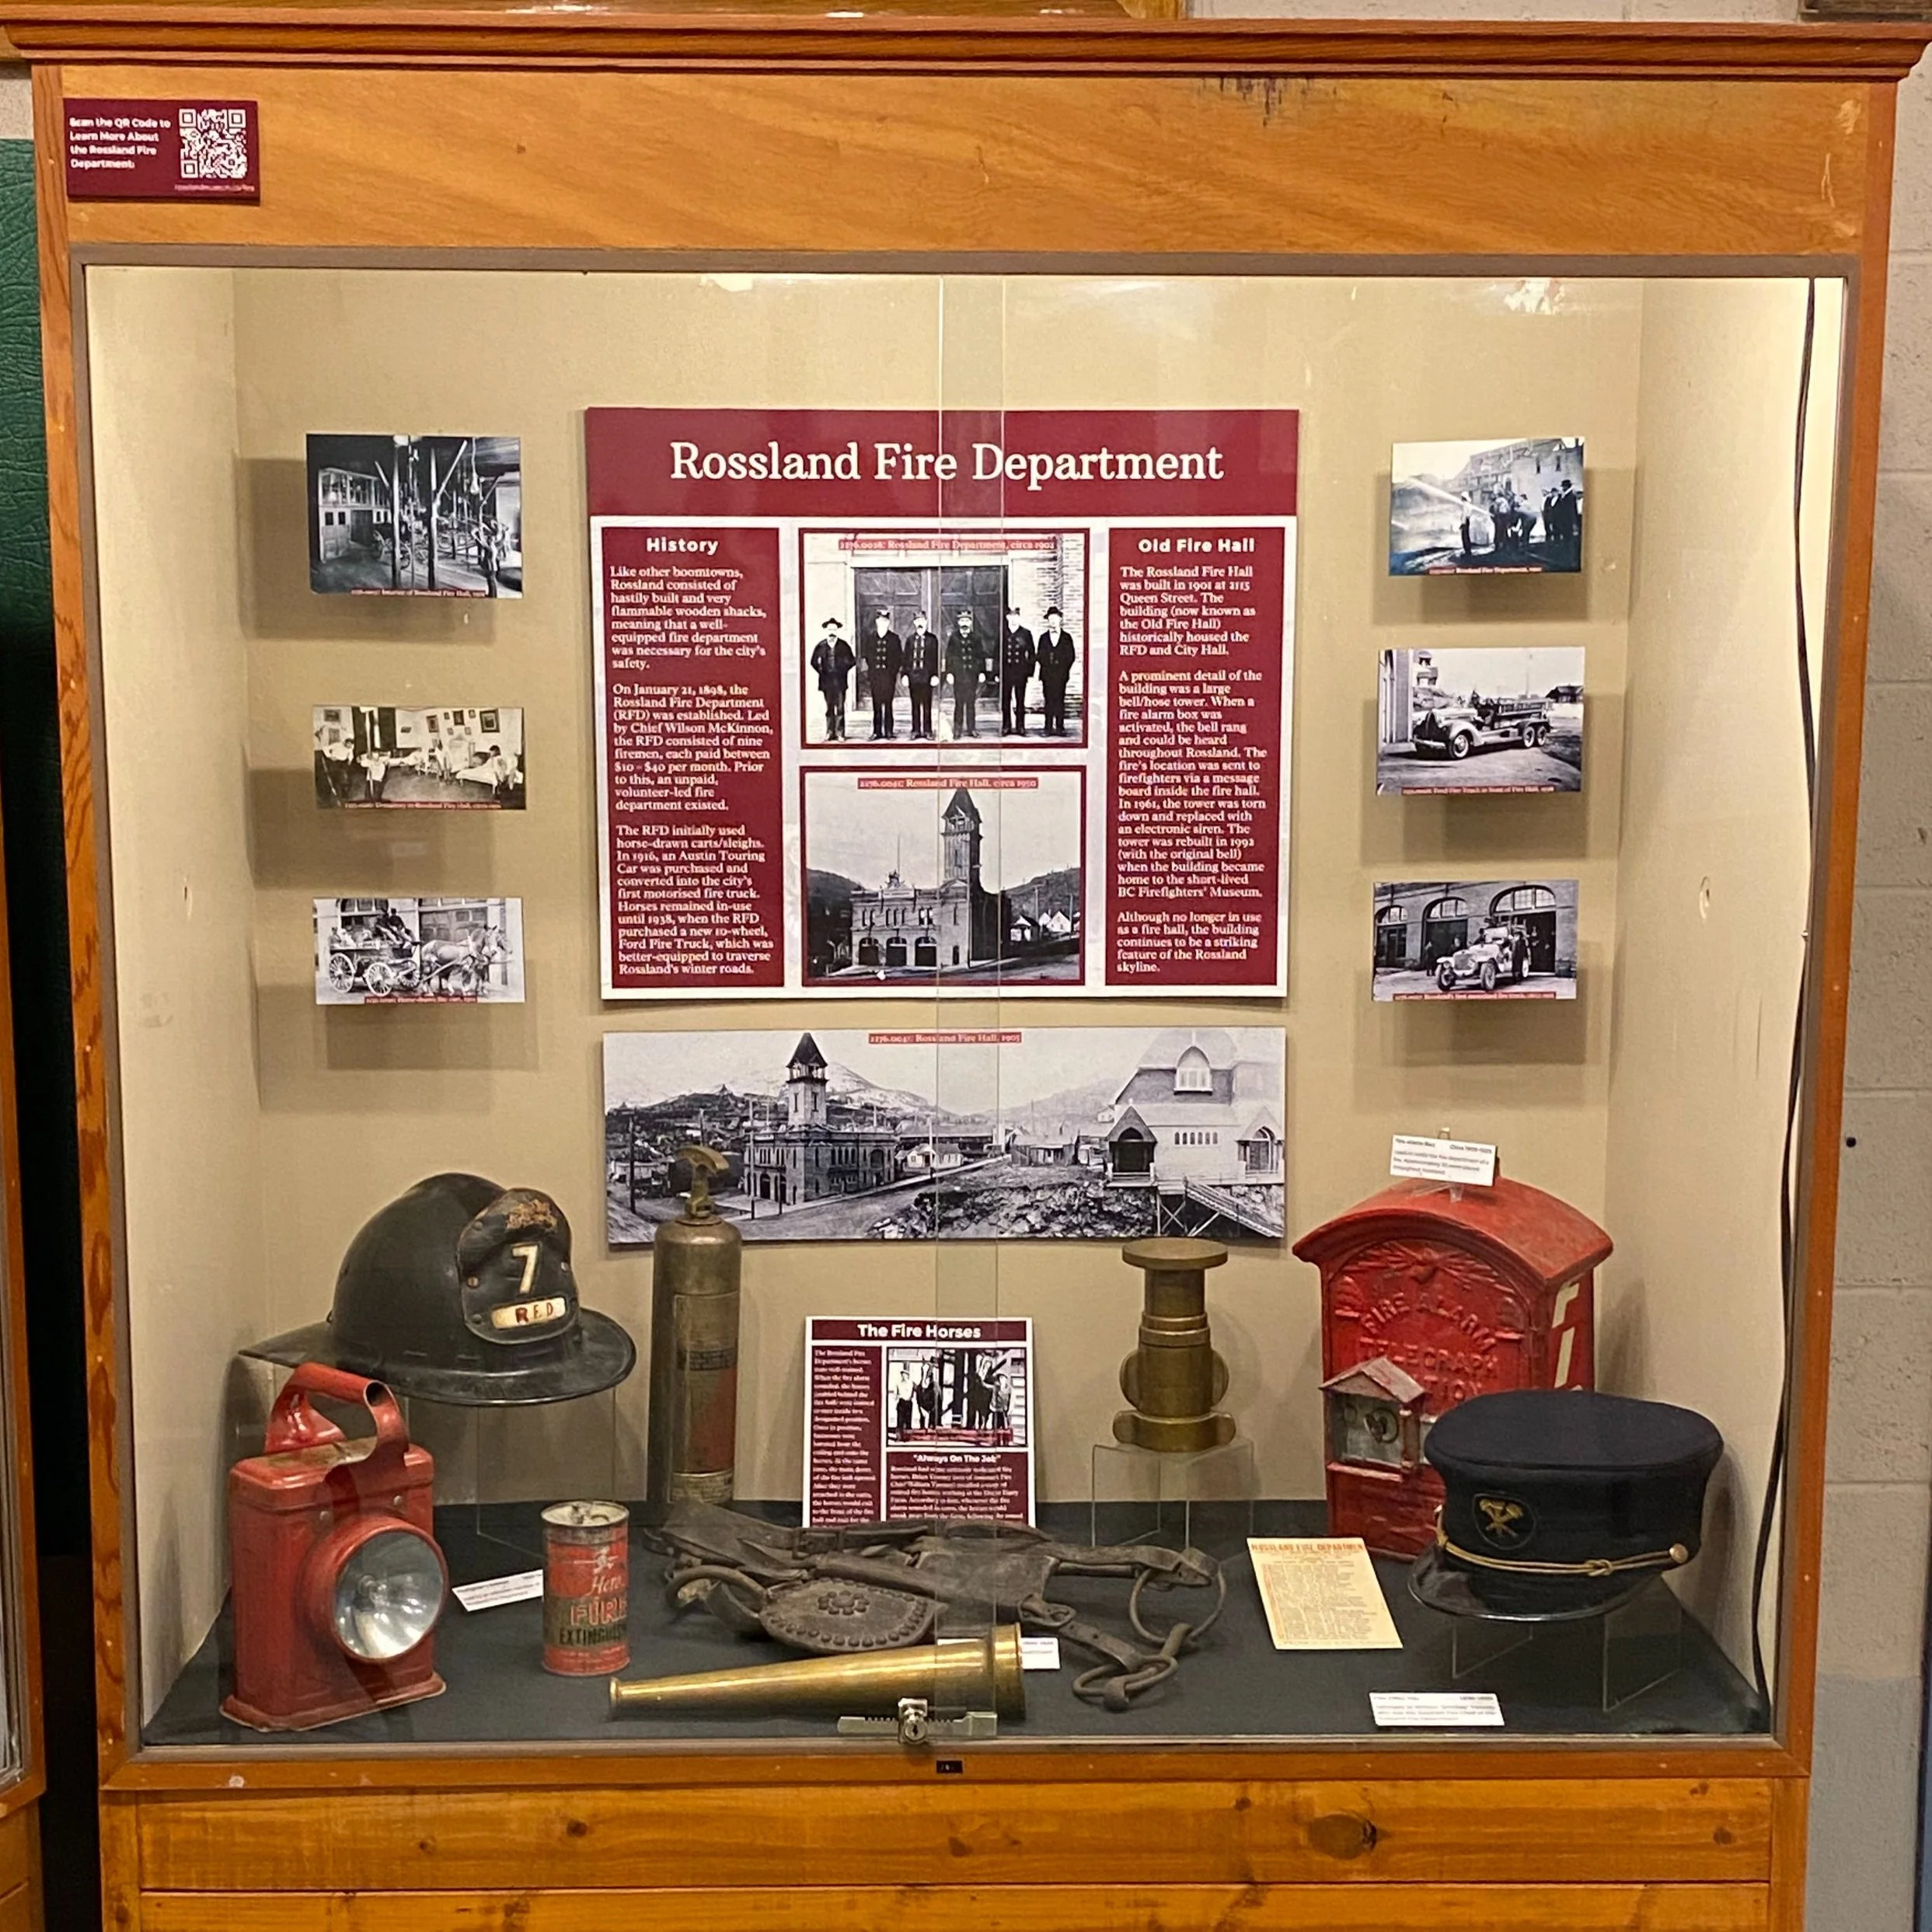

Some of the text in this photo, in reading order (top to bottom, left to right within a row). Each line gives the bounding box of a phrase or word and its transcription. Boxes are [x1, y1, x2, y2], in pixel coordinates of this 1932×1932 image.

[69, 117, 171, 128] Scan the QR Code to
[70, 131, 159, 141] Learn More About
[70, 145, 157, 155] the Rossland Fire
[671, 441, 1224, 490] Rossland Fire Department
[647, 537, 718, 555] History
[888, 540, 929, 549] Rossland
[1138, 537, 1254, 553] Old Fire Hall
[611, 567, 743, 580] Like other boomtowns,
[1121, 567, 1253, 577] The Rossland Fire Hall
[612, 581, 737, 591] Rossland consisted of
[1145, 581, 1170, 591] built
[1174, 581, 1186, 591] in
[1215, 581, 1226, 591] at
[611, 593, 731, 605] hastily built and very
[1121, 593, 1223, 605] Queen Street. The
[612, 606, 766, 619] flammable wooden shacks,
[1120, 606, 1167, 619] building
[1170, 606, 1198, 619] (now
[1202, 606, 1240, 616] known
[612, 619, 662, 632] meaning
[664, 619, 687, 629] that
[699, 619, 727, 629] well-
[1120, 619, 1222, 632] the Old Fire Hall)
[612, 633, 759, 645] equipped fire department
[1120, 633, 1250, 645] historically housed the
[636, 648, 692, 658] necessary
[695, 646, 712, 656] for
[715, 646, 734, 656] the
[736, 646, 766, 658] city's
[1120, 645, 1229, 657] RFD and City Hall.
[612, 658, 650, 671] safety.
[613, 685, 631, 695] On
[634, 685, 679, 697] January
[730, 685, 748, 695] the
[614, 698, 765, 710] Rossland Fire Department
[614, 710, 650, 723] (RFD)
[677, 710, 745, 720] established.
[748, 710, 769, 720] Led
[614, 724, 772, 736] by Chief Wilson McKinnon,
[906, 779, 947, 787] Rossland
[1118, 912, 1170, 925] Although
[1190, 912, 1226, 925] longer
[1229, 912, 1240, 922] in
[1142, 925, 1161, 935] fire
[1163, 925, 1189, 937] hall,
[1191, 925, 1209, 935] the
[1212, 925, 1259, 937] building
[1117, 937, 1172, 947] continues
[1175, 937, 1186, 947] to
[1189, 937, 1201, 947] be
[1214, 937, 1257, 950] striking
[1118, 950, 1247, 960] feature of the Rossland
[619, 964, 754, 974] Rossland's winter roads.
[1118, 962, 1160, 975] skyline.
[957, 1034, 976, 1042] Fire
[512, 1245, 539, 1294] 7
[1361, 1292, 1496, 1354] FIRE ALARM
[857, 1323, 982, 1338] The Fire Horses
